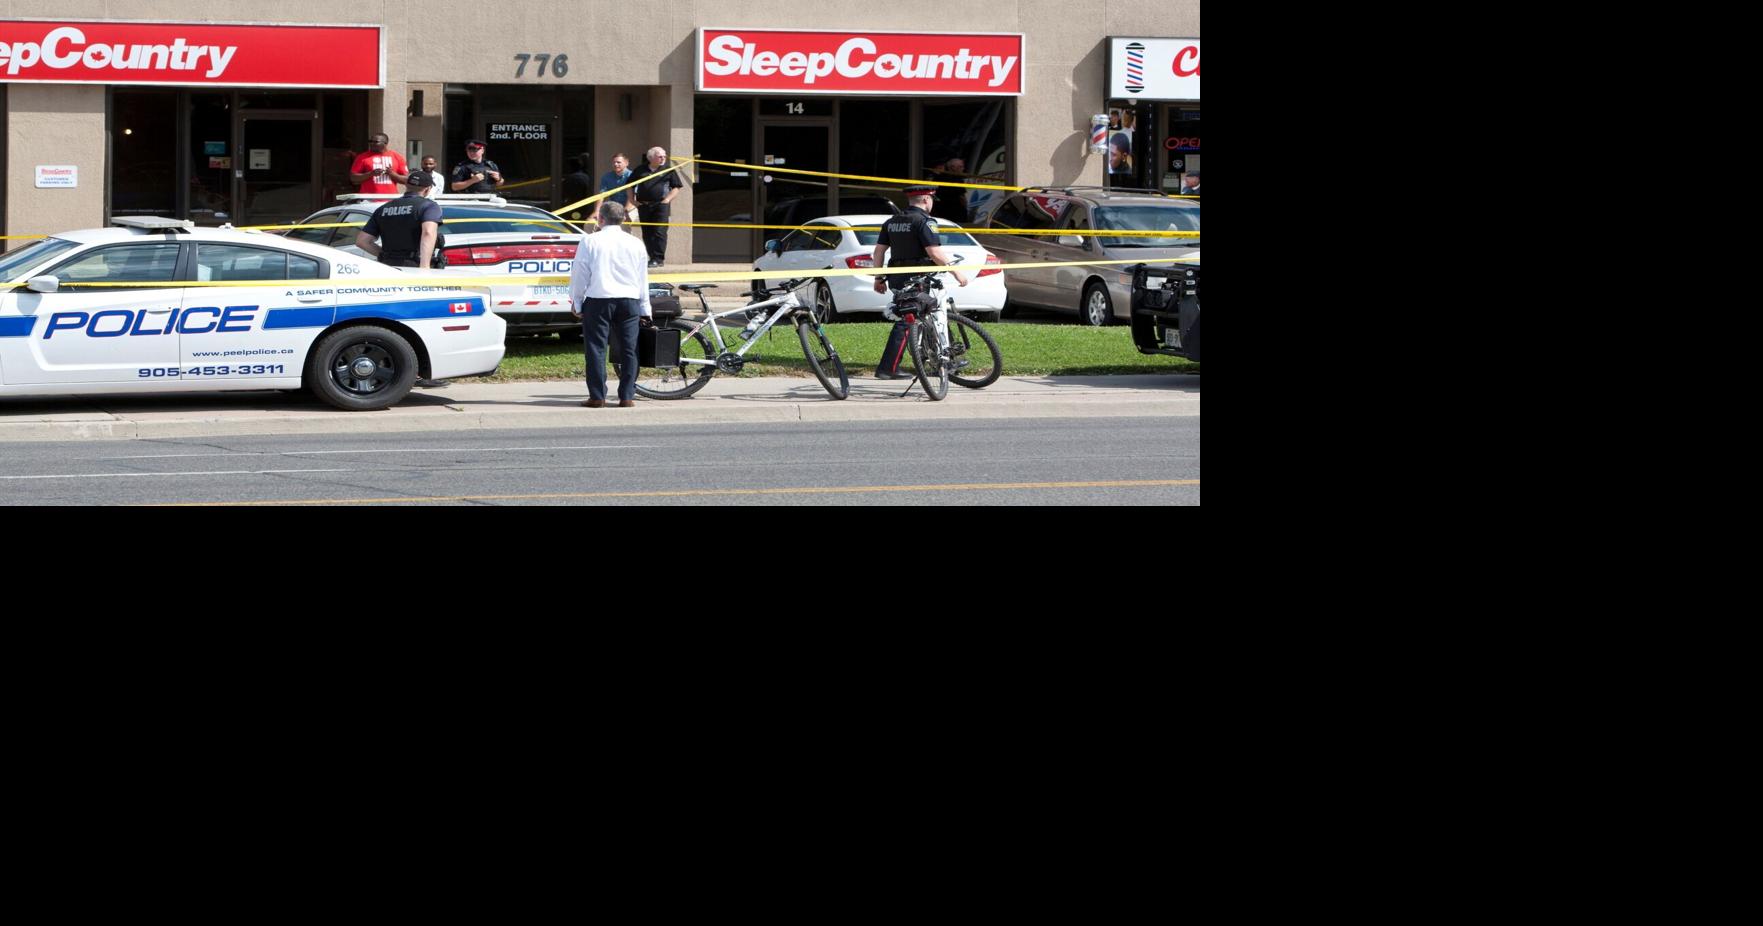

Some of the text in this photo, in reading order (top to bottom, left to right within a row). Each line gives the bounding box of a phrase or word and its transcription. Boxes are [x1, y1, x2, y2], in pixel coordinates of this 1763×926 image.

[513, 53, 569, 79] 776
[704, 35, 1017, 87] SleepCountry
[1172, 46, 1200, 77] C
[785, 102, 804, 114] 14
[491, 124, 546, 132] ENTRANCE
[490, 132, 548, 140] 2nd. FLOOR
[1165, 137, 1200, 150] OPE
[382, 205, 412, 216] POLICE
[888, 223, 911, 232] POLICE
[508, 261, 573, 273] POLIC
[296, 288, 334, 297] SAFER
[337, 286, 404, 295] COMMUNITY
[43, 305, 259, 340] POLICE
[192, 348, 294, 357] www.peelpolice.ca
[138, 364, 285, 378] 905-453-3311
